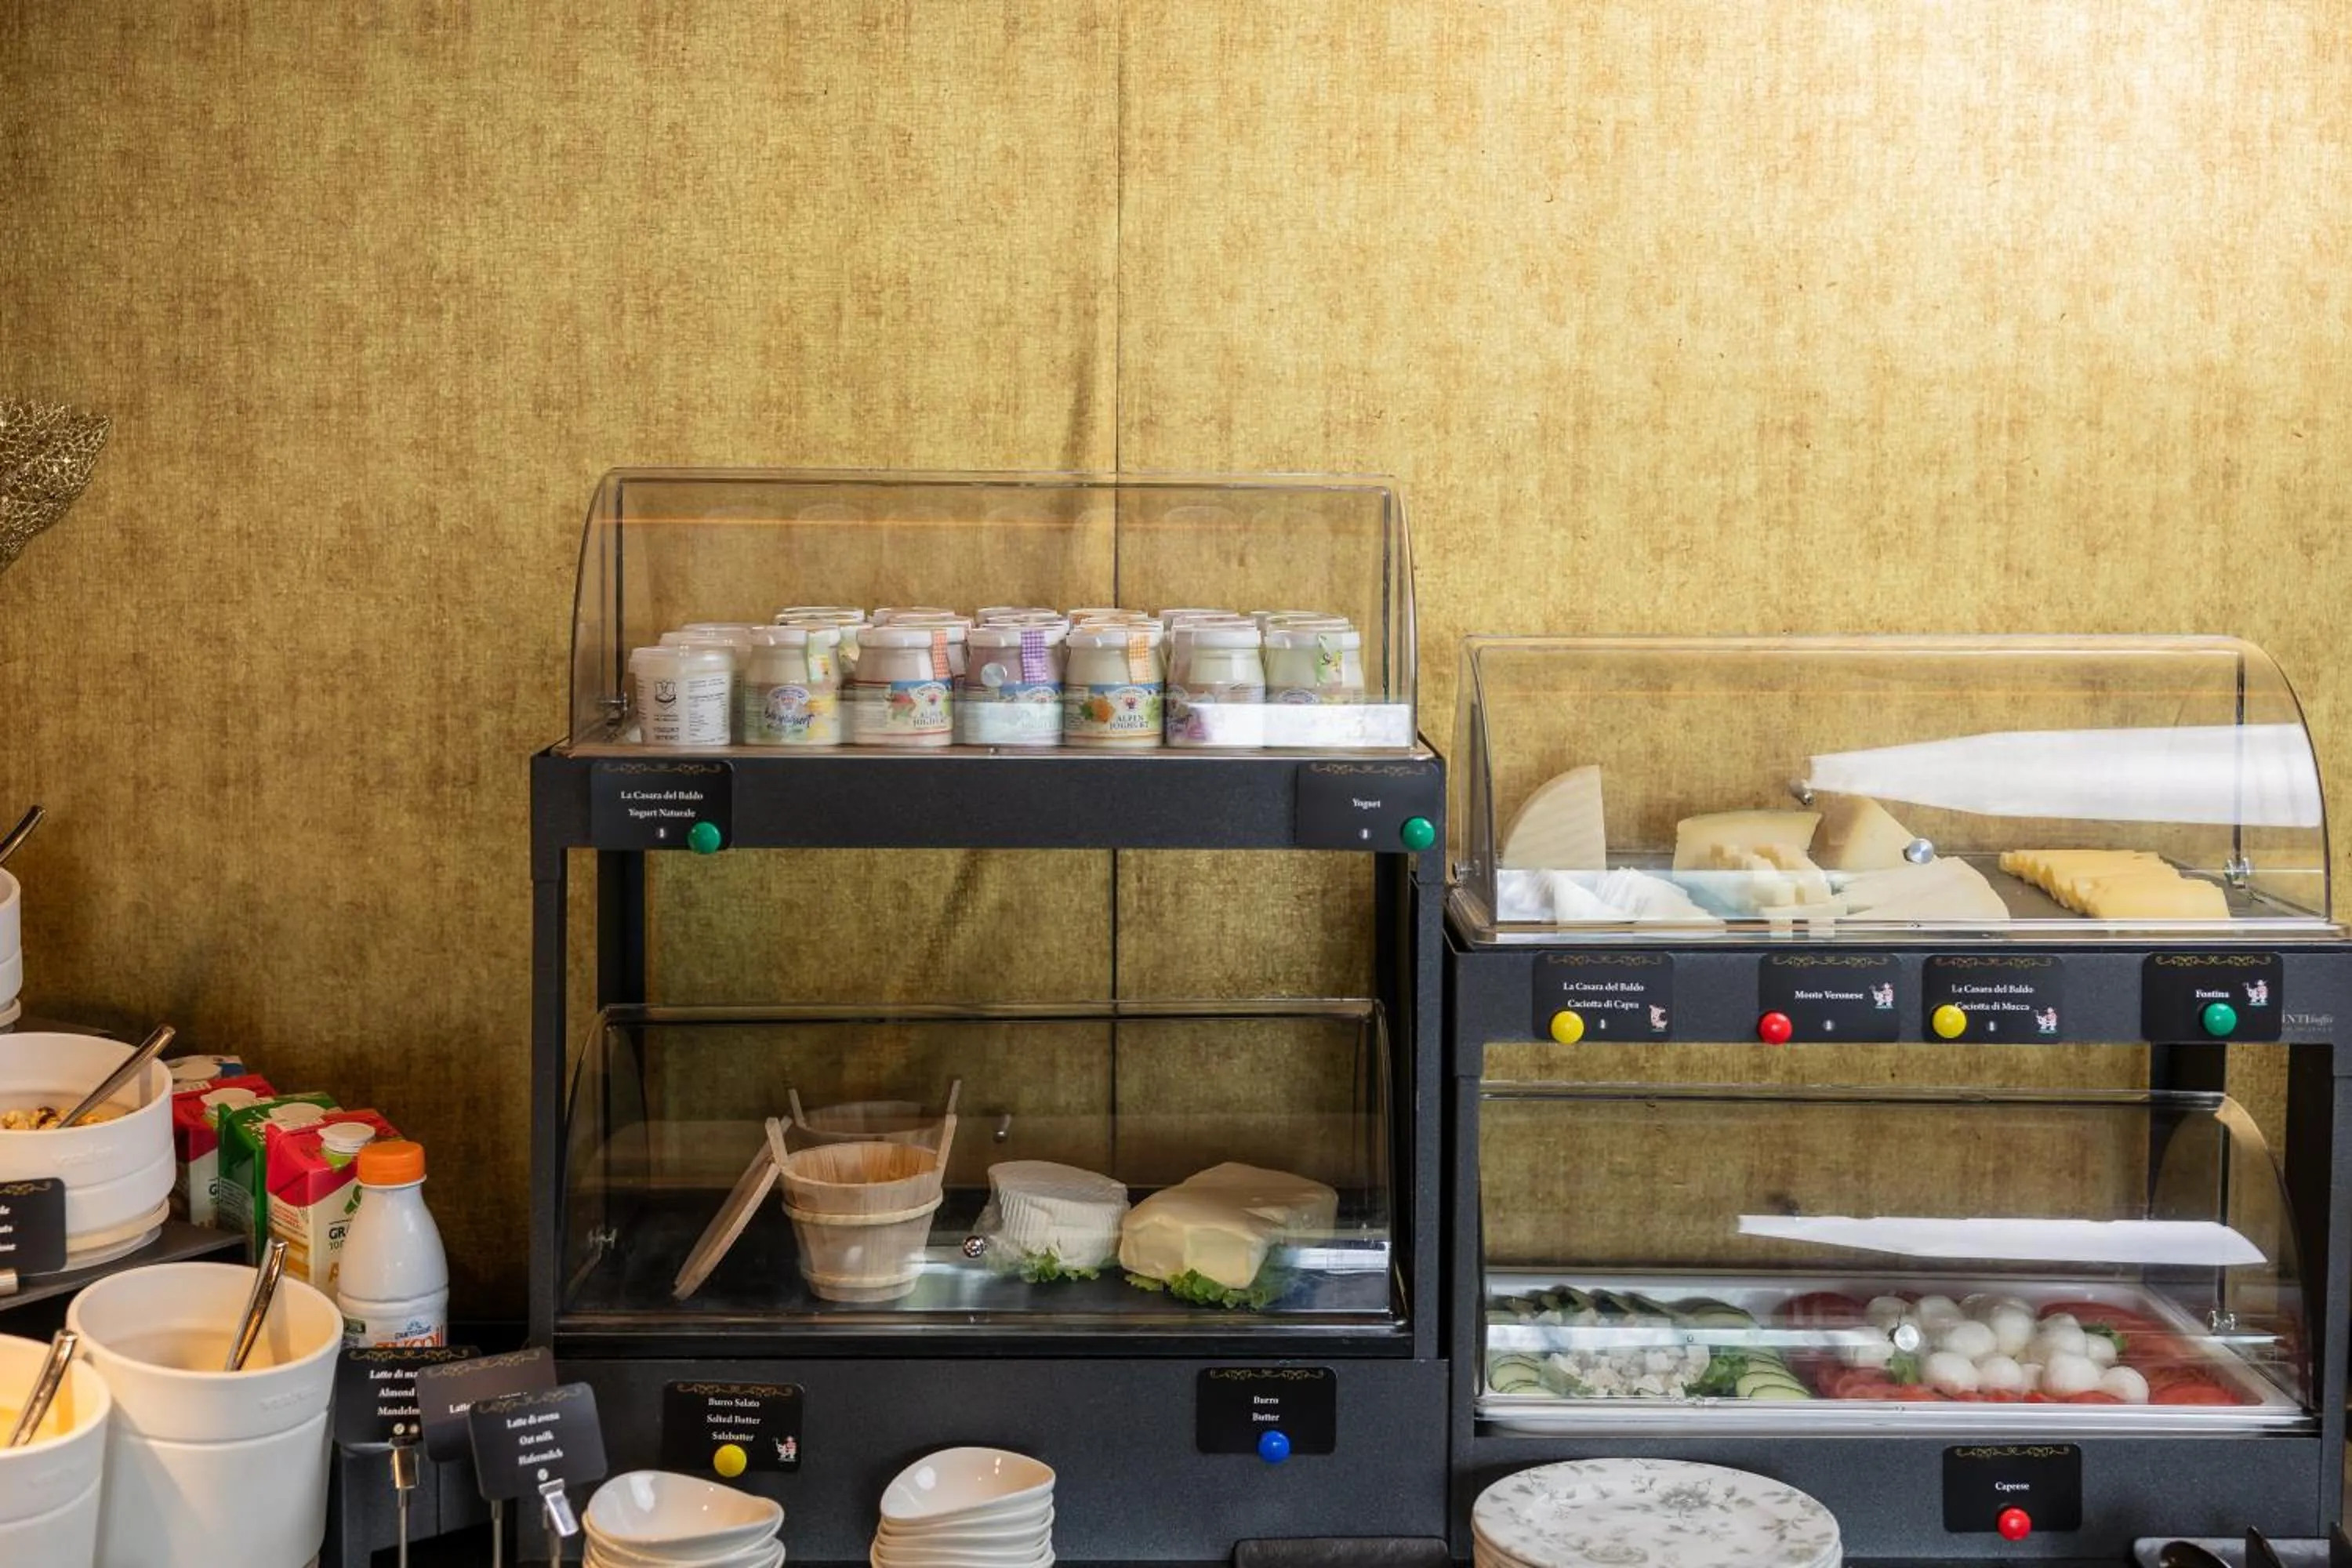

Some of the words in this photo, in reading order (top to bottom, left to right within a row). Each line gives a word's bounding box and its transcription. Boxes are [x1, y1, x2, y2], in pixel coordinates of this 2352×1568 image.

[620, 790, 632, 799] La
[663, 791, 677, 800] del
[1352, 798, 1381, 809] Yogurt
[629, 808, 658, 818] Yogurt
[659, 808, 696, 817] Naturale
[1605, 982, 1618, 992] del
[1951, 984, 1962, 993] La
[1994, 984, 2007, 993] del
[1794, 990, 1823, 1000] Monte
[1824, 990, 1864, 1000] Veronese
[2195, 989, 2230, 999] Fontina
[1568, 999, 1602, 1008] Caciotta
[1603, 1000, 1613, 1008] di
[1613, 1000, 1639, 1011] Capra
[1991, 1001, 2000, 1011] di
[369, 1369, 393, 1379] Latte
[394, 1368, 403, 1379] di
[379, 1387, 416, 1398] Almond
[708, 1397, 733, 1406] Burro
[734, 1398, 760, 1408] Salato
[1254, 1395, 1279, 1404] Burro
[506, 1417, 527, 1429] Latte
[528, 1414, 537, 1425] di
[538, 1412, 561, 1423] avena
[706, 1414, 734, 1424] Salted
[734, 1414, 761, 1425] Butter
[1253, 1411, 1280, 1421] Butter
[519, 1433, 535, 1446] Oat
[535, 1429, 554, 1443] milk
[518, 1448, 564, 1466] Hafermilch
[1994, 1480, 2031, 1493] Caprese
